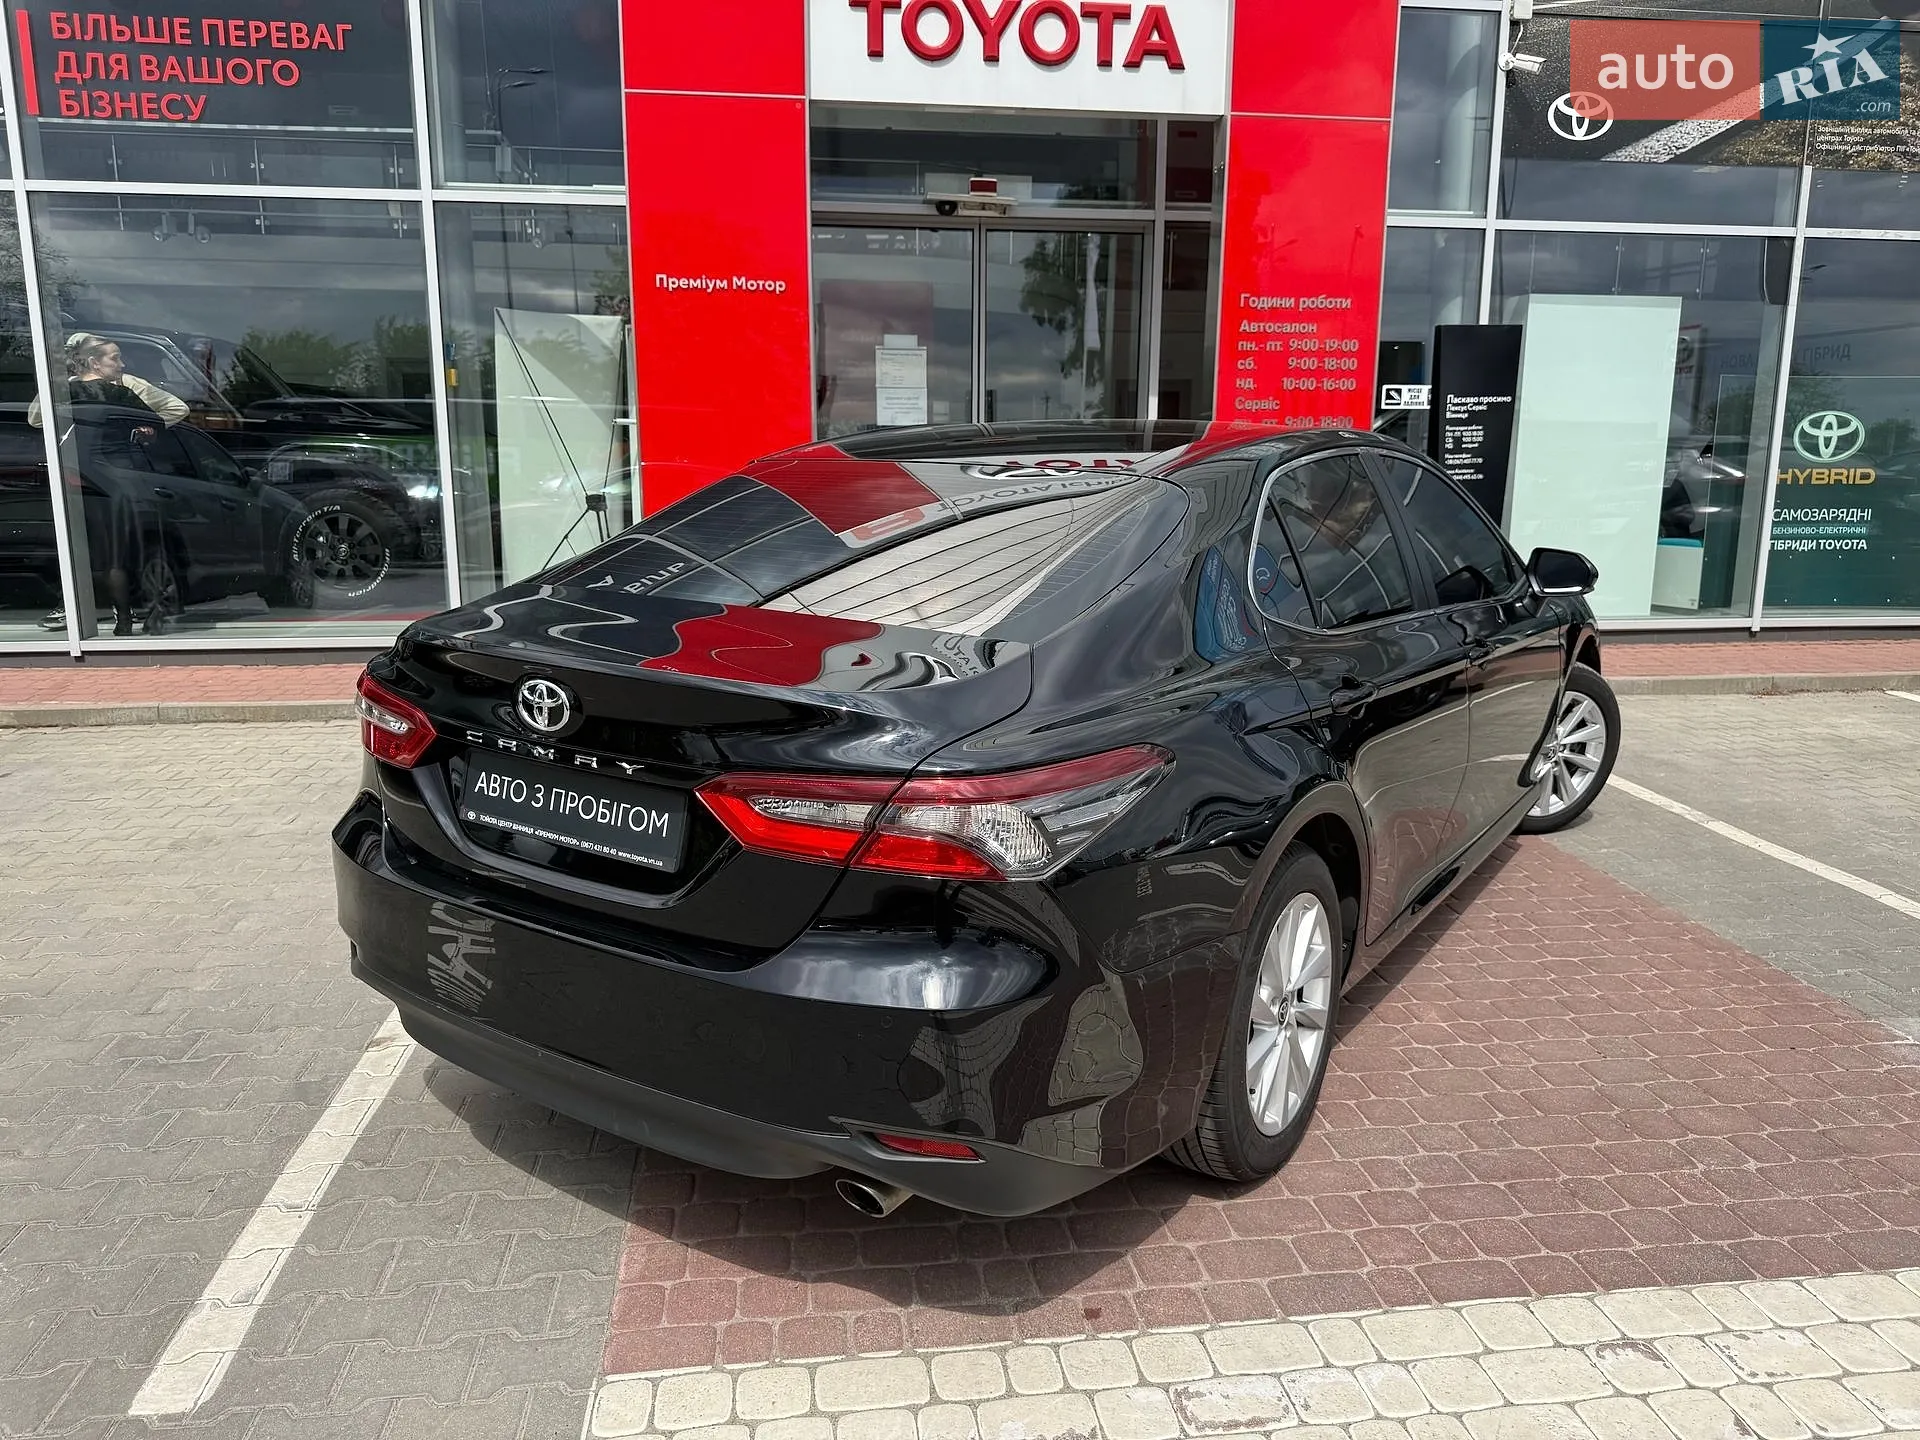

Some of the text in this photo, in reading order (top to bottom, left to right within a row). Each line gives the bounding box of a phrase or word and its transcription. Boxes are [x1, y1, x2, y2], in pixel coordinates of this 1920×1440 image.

[50, 12, 352, 51] БІЛЬШЕ ПЕРЕВАГ
[849, 0, 1185, 70] TOYOTA
[54, 50, 300, 87] ДЛЯ ВАШОГО
[58, 89, 207, 121] БІЗНЕСУ
[1843, 135, 1863, 143] Toyota
[655, 273, 786, 294] Преміум Мотор
[1240, 293, 1352, 311] Години роботи
[1239, 320, 1318, 334] Автосалон
[1288, 339, 1359, 352] 9:00-19:00
[1237, 357, 1358, 370] сб. 9:00-18:00
[1236, 377, 1357, 391] нд. 10:00-16:00
[1235, 396, 1280, 412] Сервіс
[1479, 395, 1512, 404] просимо
[1776, 468, 1876, 485] HYBRID
[1772, 508, 1872, 522] САМОЗАРЯДНІ
[1772, 526, 1867, 535] БЕНЗИНОВО-ЕЛЕКТРИЧНІ
[1769, 539, 1868, 552] ГІБРИДИ TOYOTA
[466, 730, 645, 775] CAMRY
[474, 771, 527, 803] АВТО
[549, 788, 669, 838] ПРОБІГОМ
[480, 814, 498, 825] ТОЙОТА
[580, 840, 594, 851] (067)
[594, 844, 603, 852] 431
[603, 846, 610, 854] 80
[610, 848, 617, 856] 40
